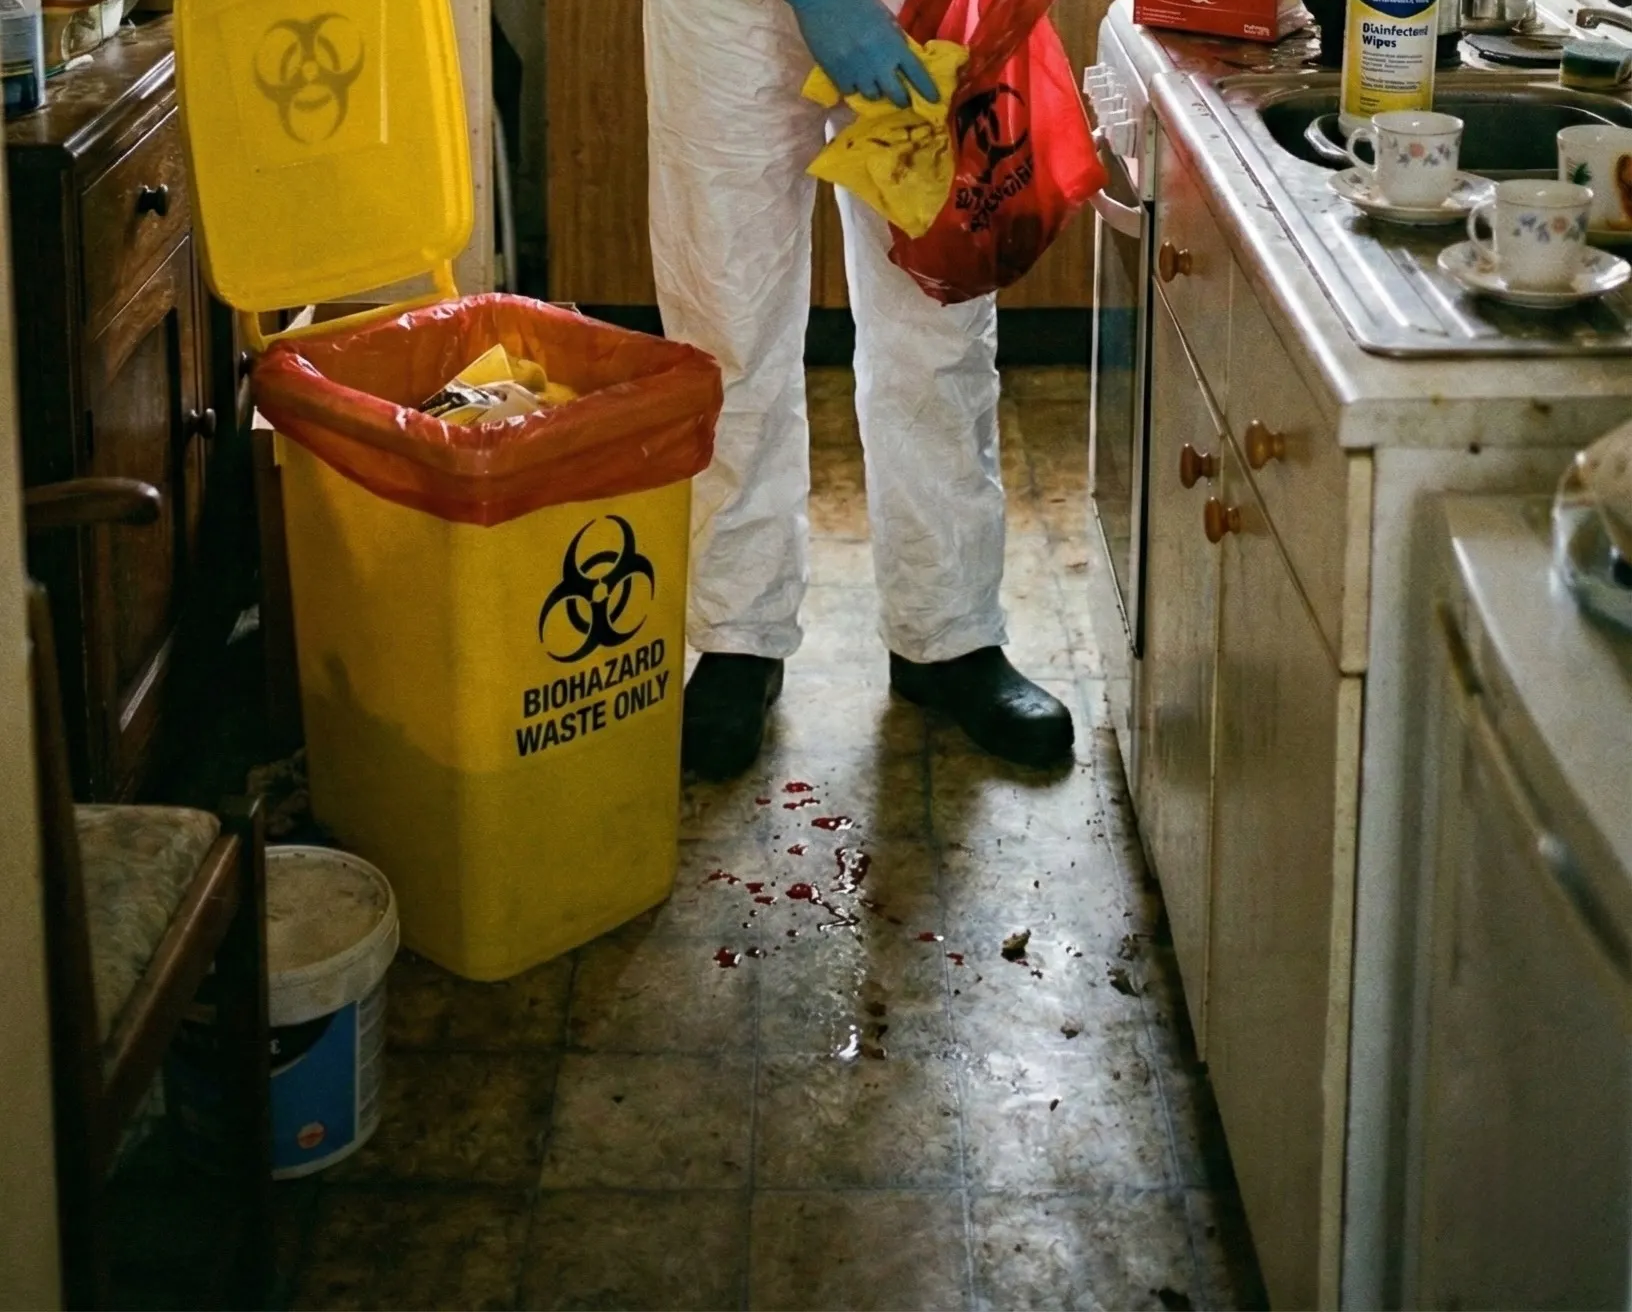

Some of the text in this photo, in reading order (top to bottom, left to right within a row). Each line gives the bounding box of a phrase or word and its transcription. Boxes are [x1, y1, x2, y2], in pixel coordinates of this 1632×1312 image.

[516, 670, 670, 757] WASTE ONLY
[523, 638, 665, 719] BIOHAZARD
